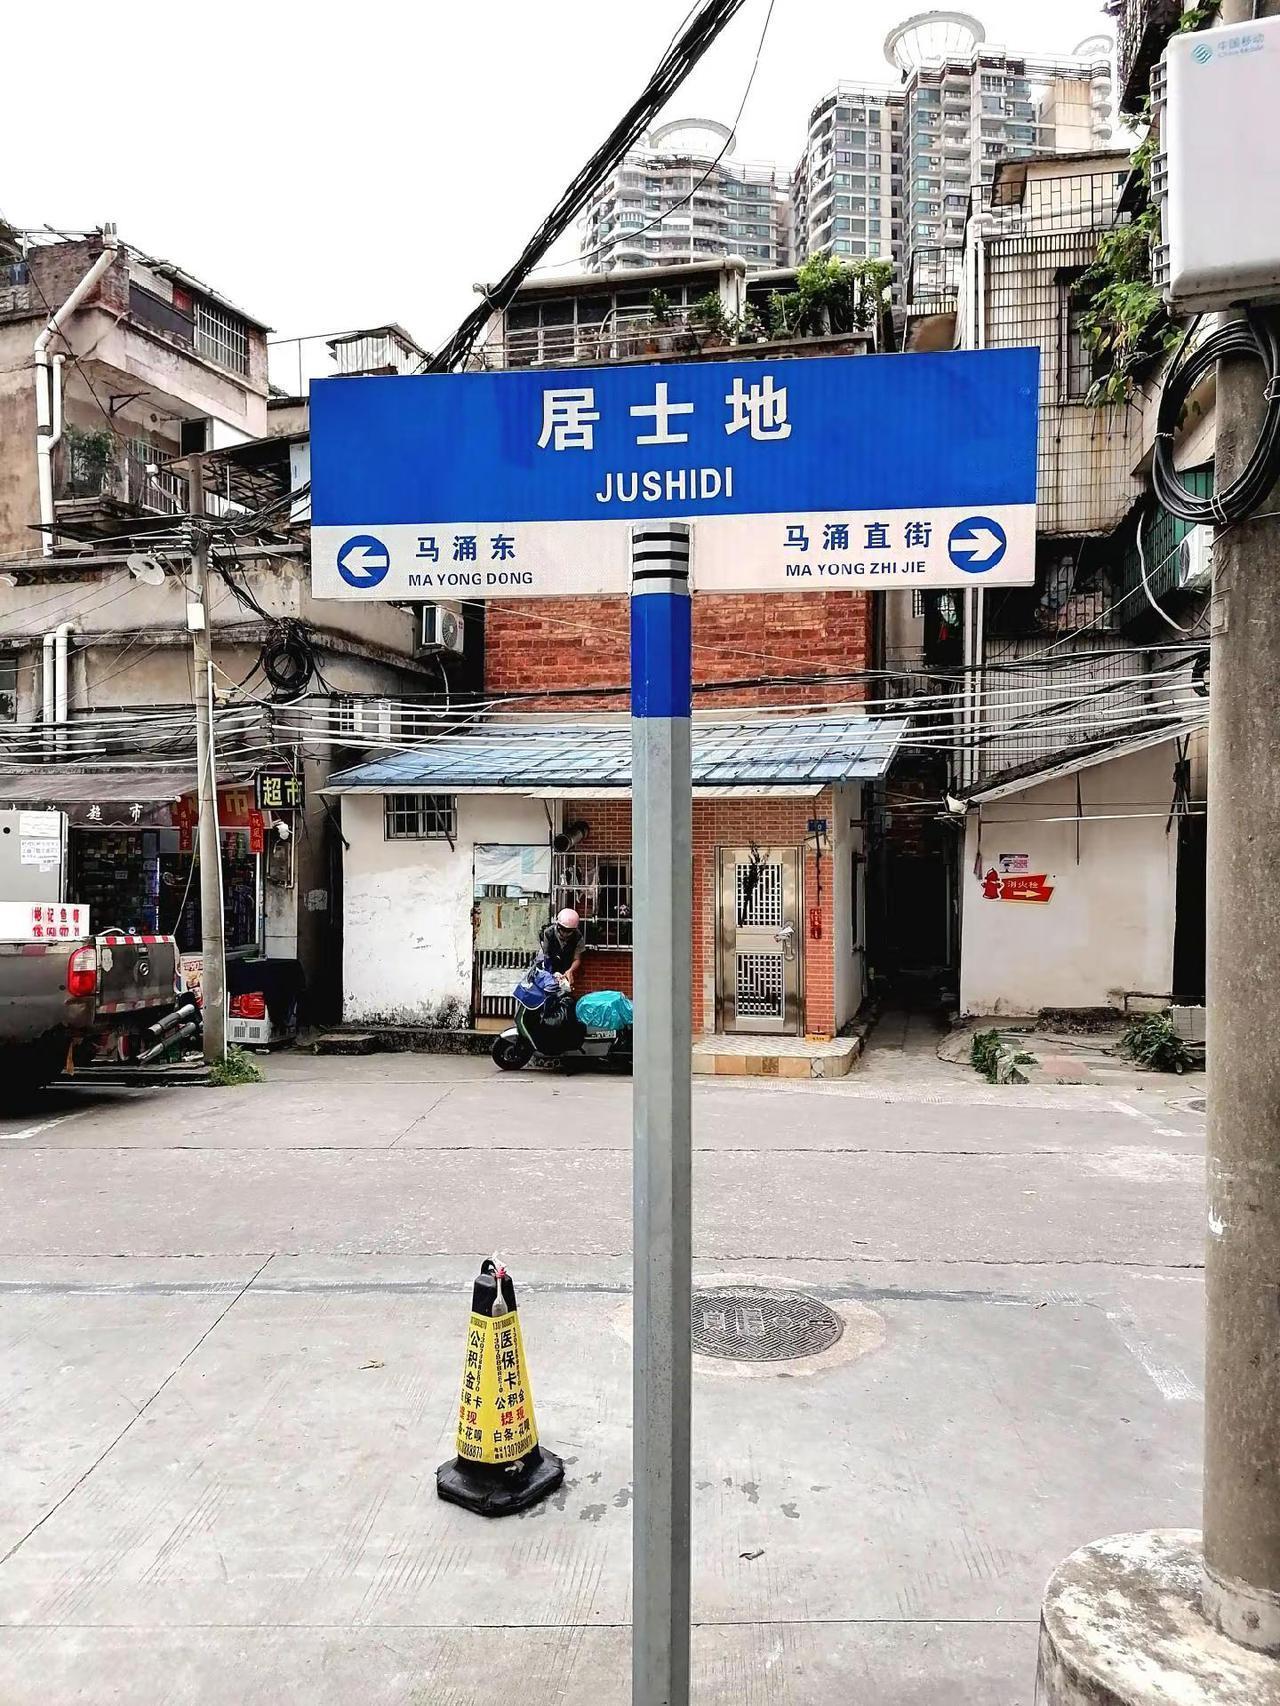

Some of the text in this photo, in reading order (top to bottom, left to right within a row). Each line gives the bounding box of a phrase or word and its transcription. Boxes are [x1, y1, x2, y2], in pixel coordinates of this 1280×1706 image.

[537, 375, 792, 451] 居士地
[595, 466, 734, 503] JUSHIDI
[415, 533, 516, 563] 马涌东
[783, 521, 932, 552] 马涌直街
[408, 571, 533, 587] MA YONG DONG
[785, 561, 926, 577] MA YONG ZHI JIE
[262, 776, 302, 807] 超市
[466, 1330, 481, 1391] 公积金
[500, 1329, 517, 1390] 医保卡
[495, 1388, 525, 1410] 公积金
[500, 1405, 525, 1427] 提现
